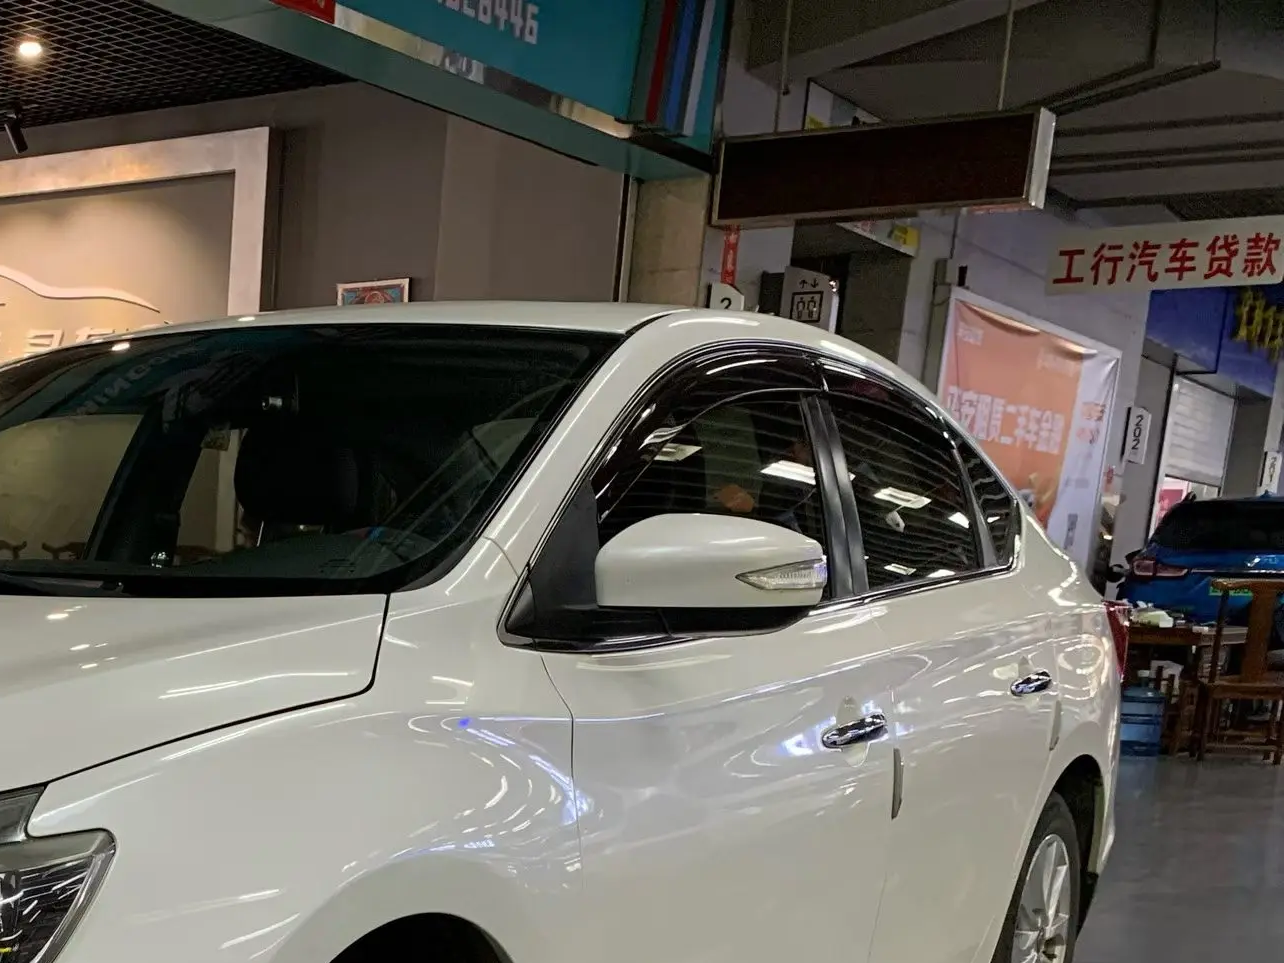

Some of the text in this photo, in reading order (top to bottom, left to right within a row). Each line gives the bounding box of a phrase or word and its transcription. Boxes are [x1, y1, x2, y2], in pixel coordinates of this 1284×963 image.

[1052, 231, 1281, 286] 工行汽车贷款
[1131, 414, 1144, 450] 202
